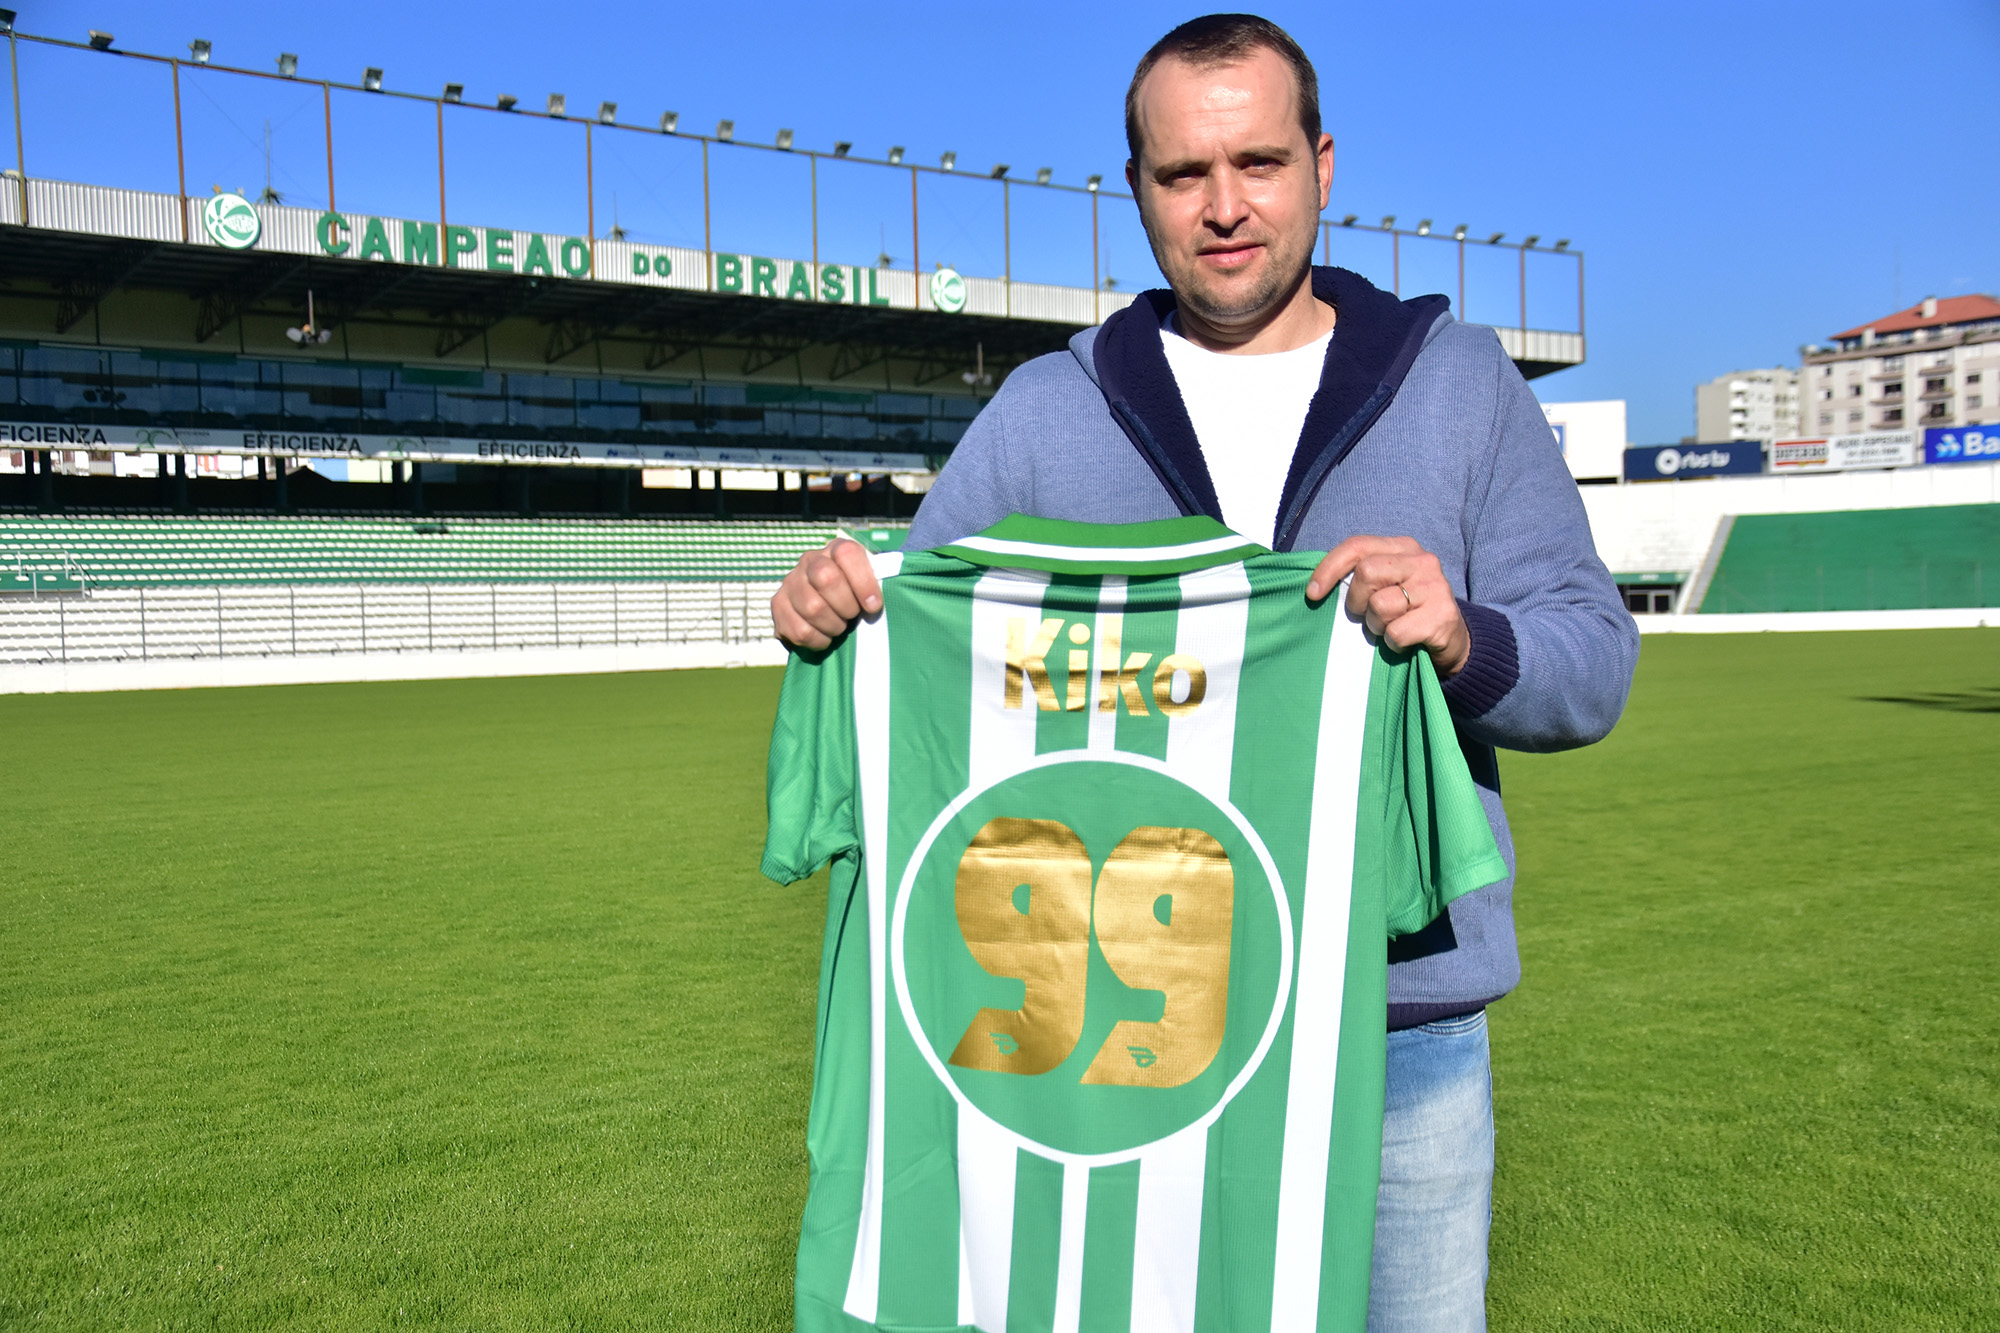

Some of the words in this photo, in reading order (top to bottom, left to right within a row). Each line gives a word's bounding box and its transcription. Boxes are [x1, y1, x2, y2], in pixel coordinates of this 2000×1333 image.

[317, 211, 591, 278] CAMPEAO
[633, 252, 671, 277] DO
[717, 253, 890, 306] BRASIL
[242, 432, 362, 453] EFFICIENZA
[477, 441, 581, 459] EFFICIENZA
[1004, 615, 1207, 717] Kiko
[947, 816, 1234, 1088] 99
